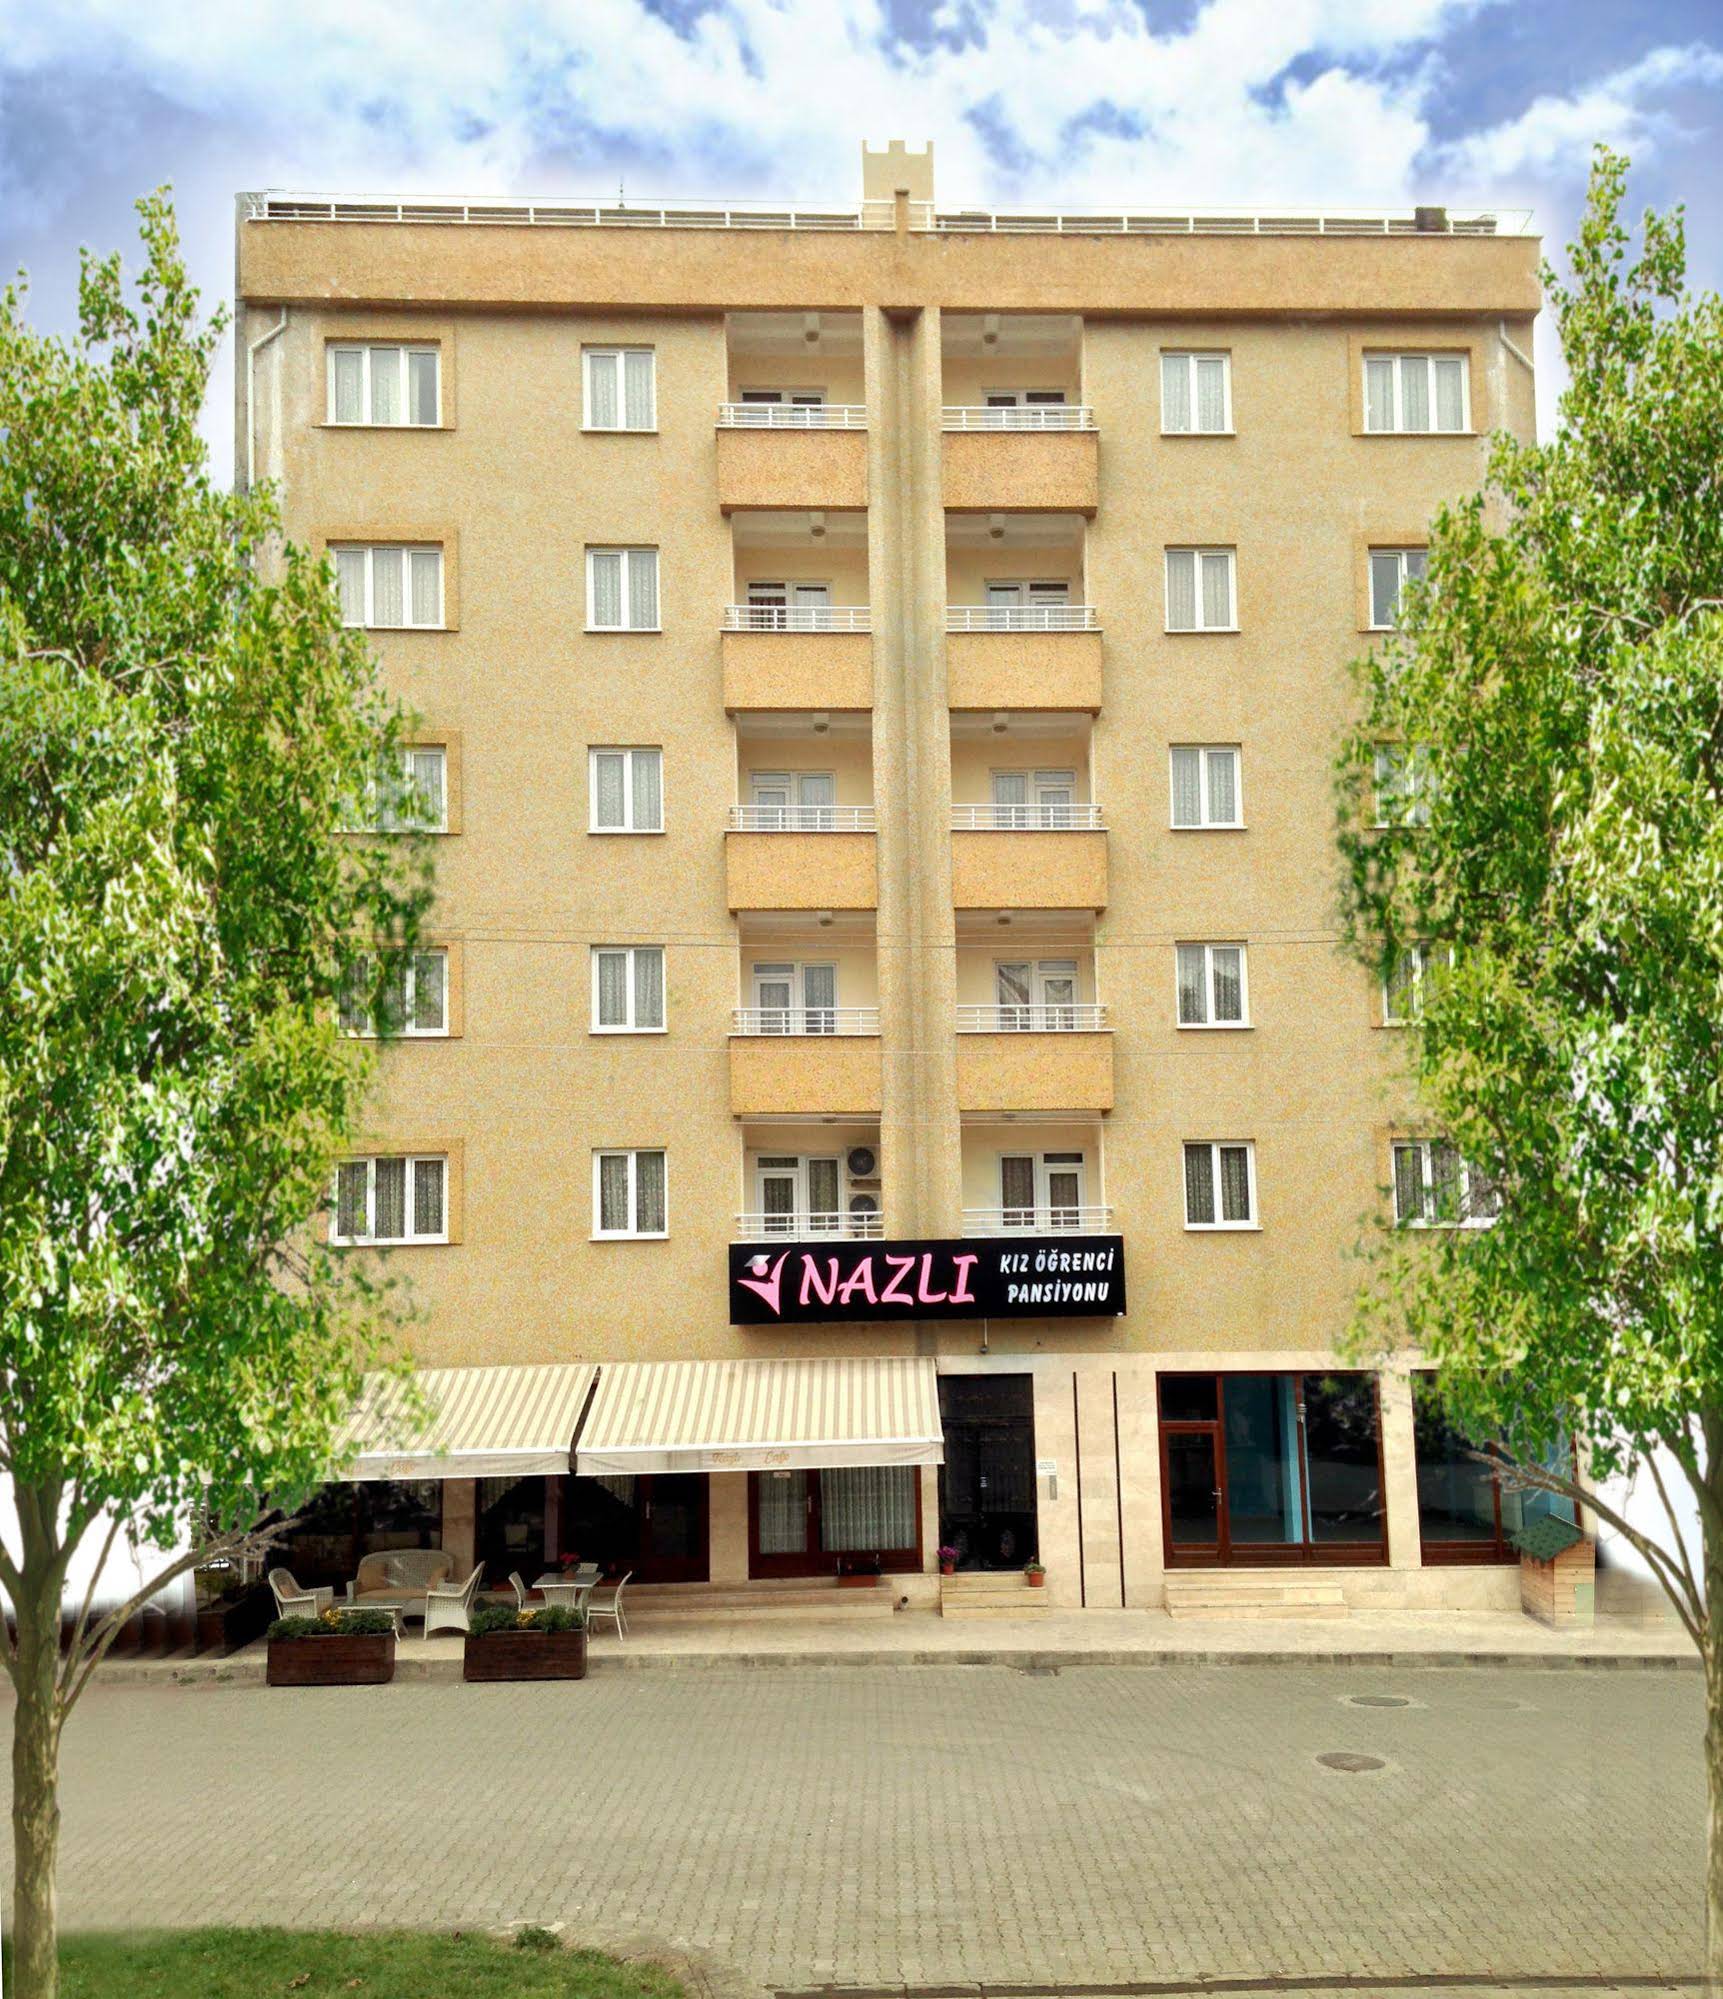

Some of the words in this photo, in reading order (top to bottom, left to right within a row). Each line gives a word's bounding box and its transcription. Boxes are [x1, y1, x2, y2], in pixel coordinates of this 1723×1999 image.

[1000, 1254, 1029, 1274] KIZ
[1035, 1248, 1114, 1273] ÖĞRENCİ
[800, 1253, 978, 1305] NAZLI
[1007, 1279, 1109, 1303] PANSİYONU
